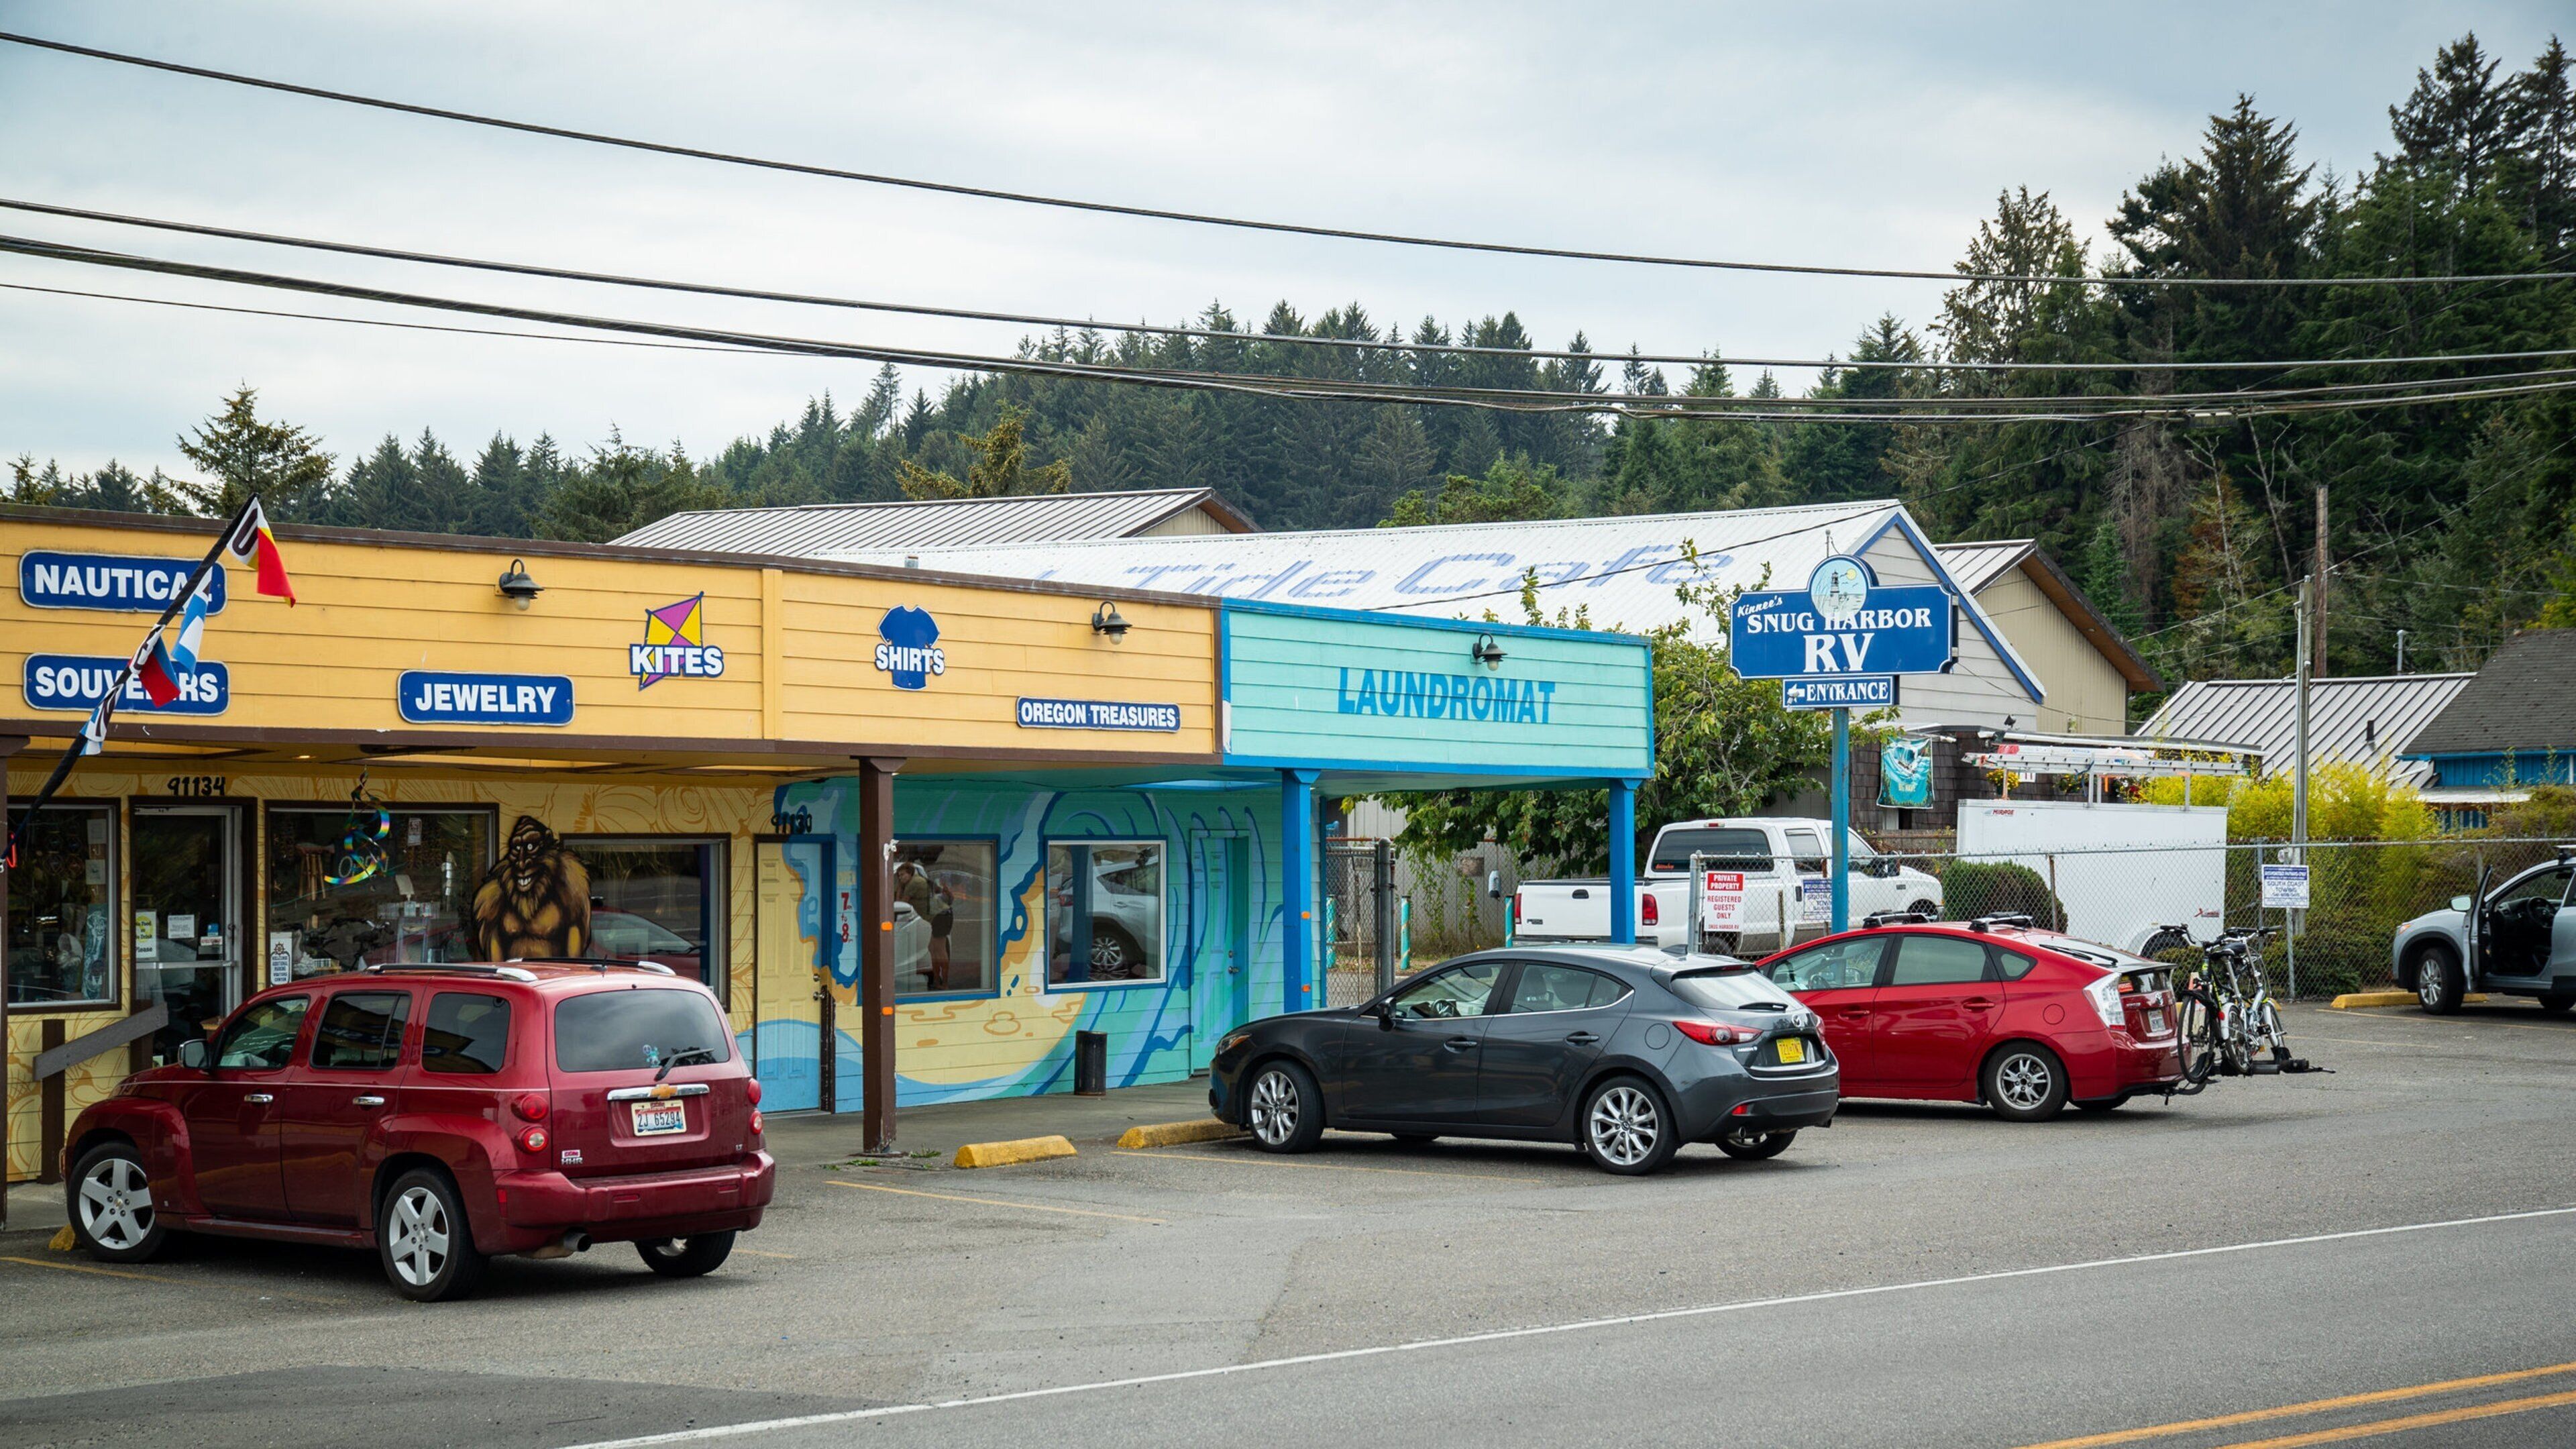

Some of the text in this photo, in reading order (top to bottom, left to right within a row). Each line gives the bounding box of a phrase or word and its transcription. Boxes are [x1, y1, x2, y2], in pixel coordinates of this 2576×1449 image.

[35, 564, 212, 602] NAUTICA
[1124, 544, 1733, 598] Tide Cafe
[1736, 595, 1782, 617] Kinnee's
[1748, 608, 1932, 633] SNUG HARBOR
[630, 645, 724, 676] KITES
[875, 644, 945, 675] SHIRTS
[1803, 633, 1874, 673] RV
[36, 666, 218, 702] SOUVERS
[1338, 667, 1555, 724] LAUNDROMAT
[1807, 682, 1888, 701] ENTRANCE
[415, 683, 556, 713] JEWELRY
[1021, 702, 1177, 728] OREGON TREASURES
[167, 776, 226, 797] 91134
[1711, 882, 1739, 890] PROPERTY
[1713, 874, 1737, 882] PRIVATE
[1707, 895, 1741, 903] REGISTERED
[561, 1157, 583, 1165] HHR
